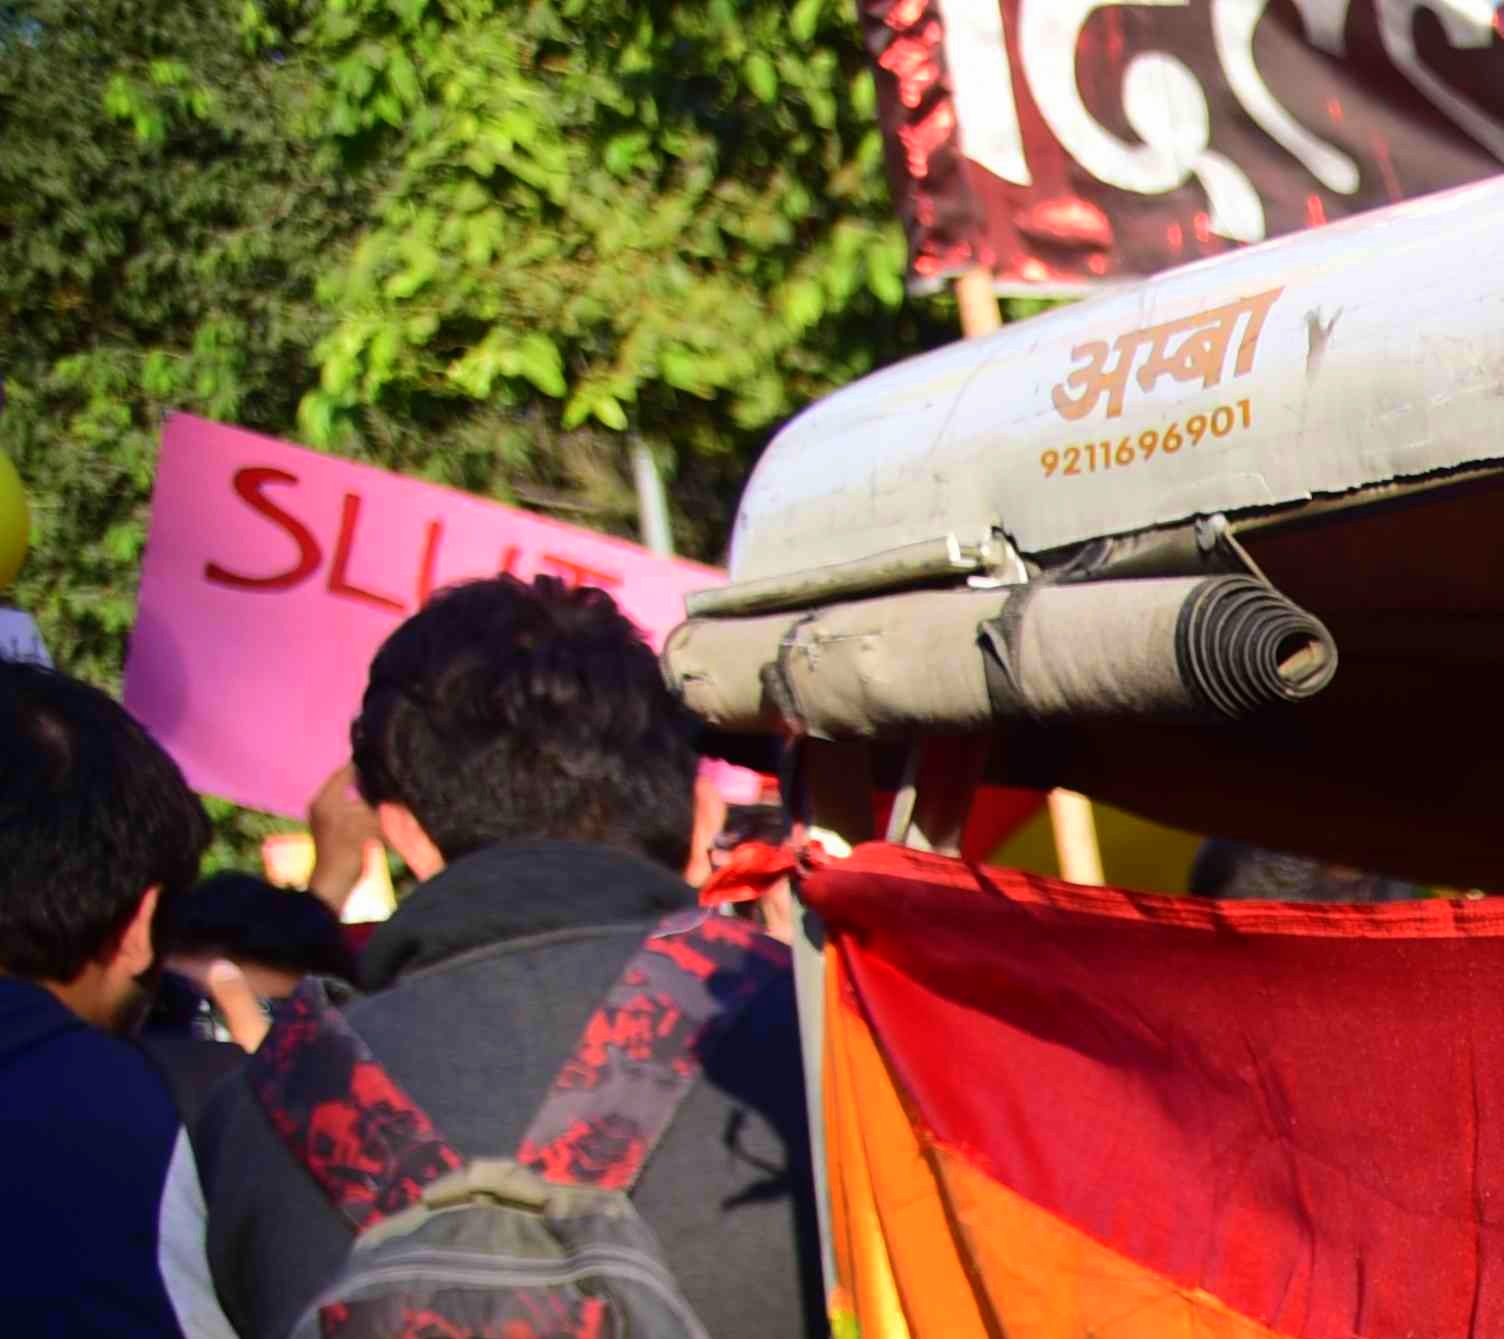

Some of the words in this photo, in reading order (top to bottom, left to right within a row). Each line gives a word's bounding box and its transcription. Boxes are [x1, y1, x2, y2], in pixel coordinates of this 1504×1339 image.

[1051, 286, 1285, 422] अम्बा
[1040, 398, 1252, 478] 9211696901
[205, 466, 622, 612] SL
